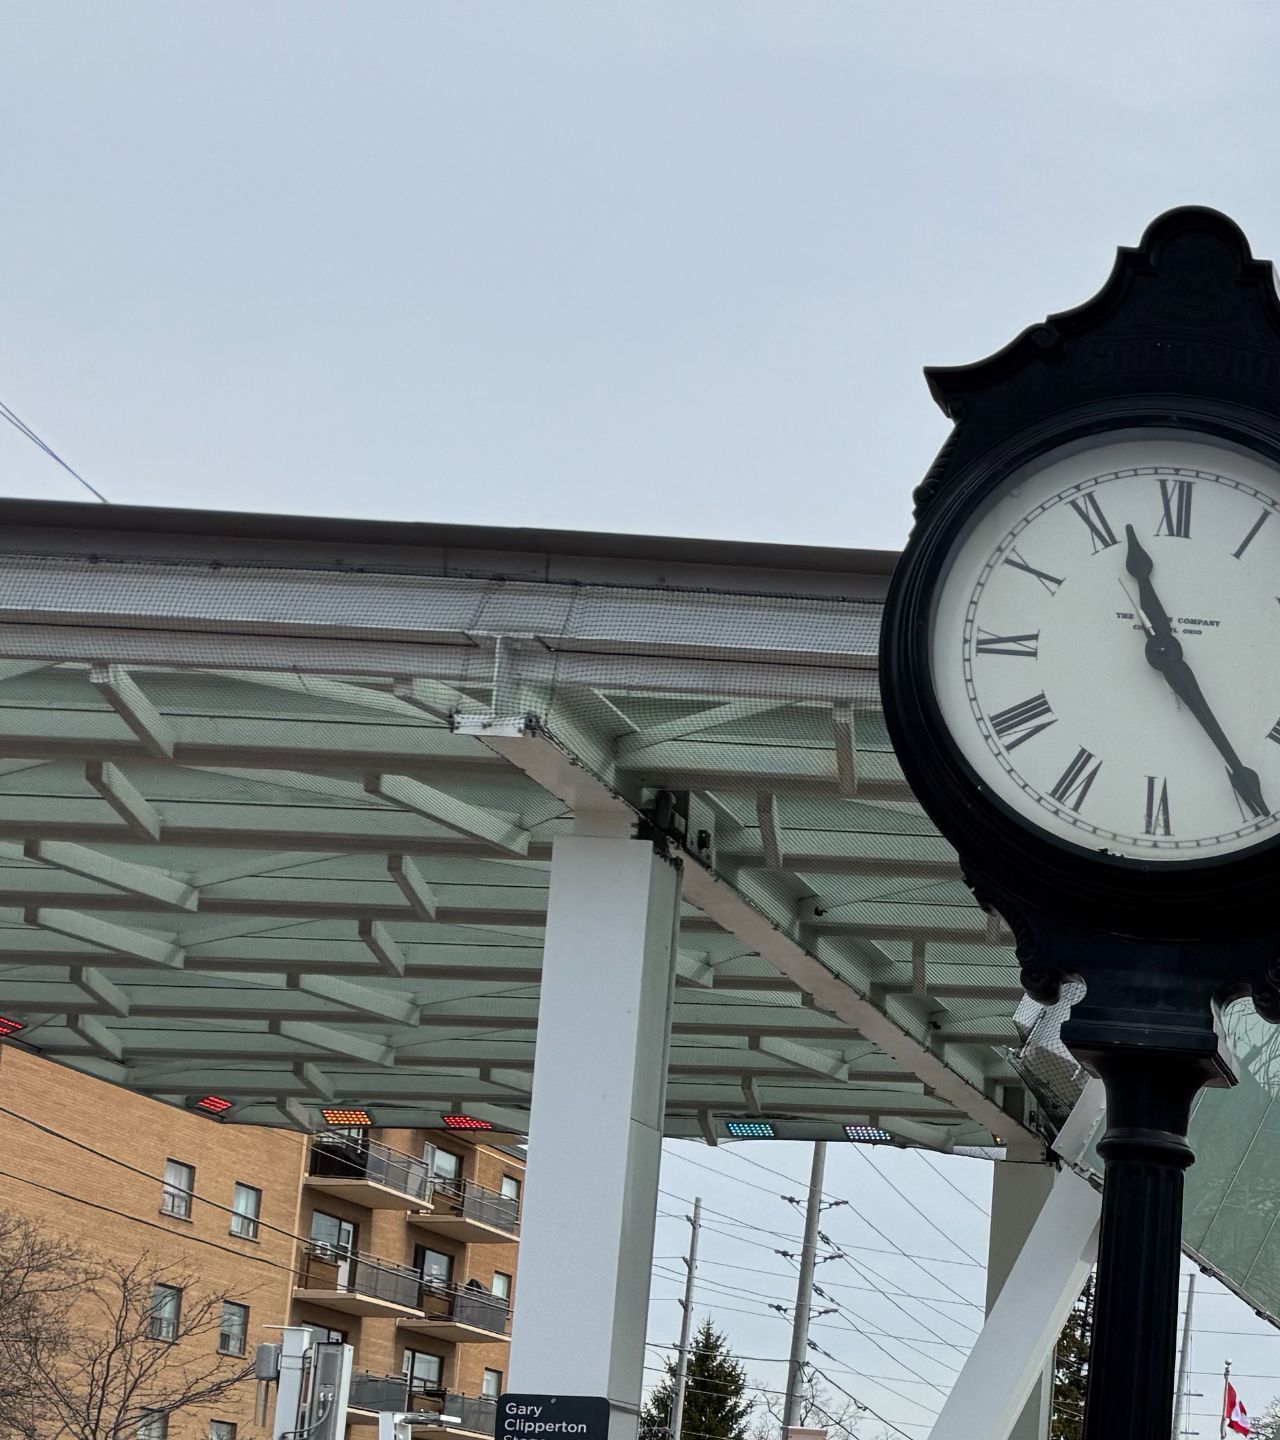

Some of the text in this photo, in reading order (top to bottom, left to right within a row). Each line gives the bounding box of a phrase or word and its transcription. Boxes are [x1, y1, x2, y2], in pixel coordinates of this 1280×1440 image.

[1115, 612, 1134, 620] THE
[1177, 617, 1220, 627] COMPANY
[505, 1403, 542, 1417] Gary
[504, 1419, 587, 1433] Clipperton
